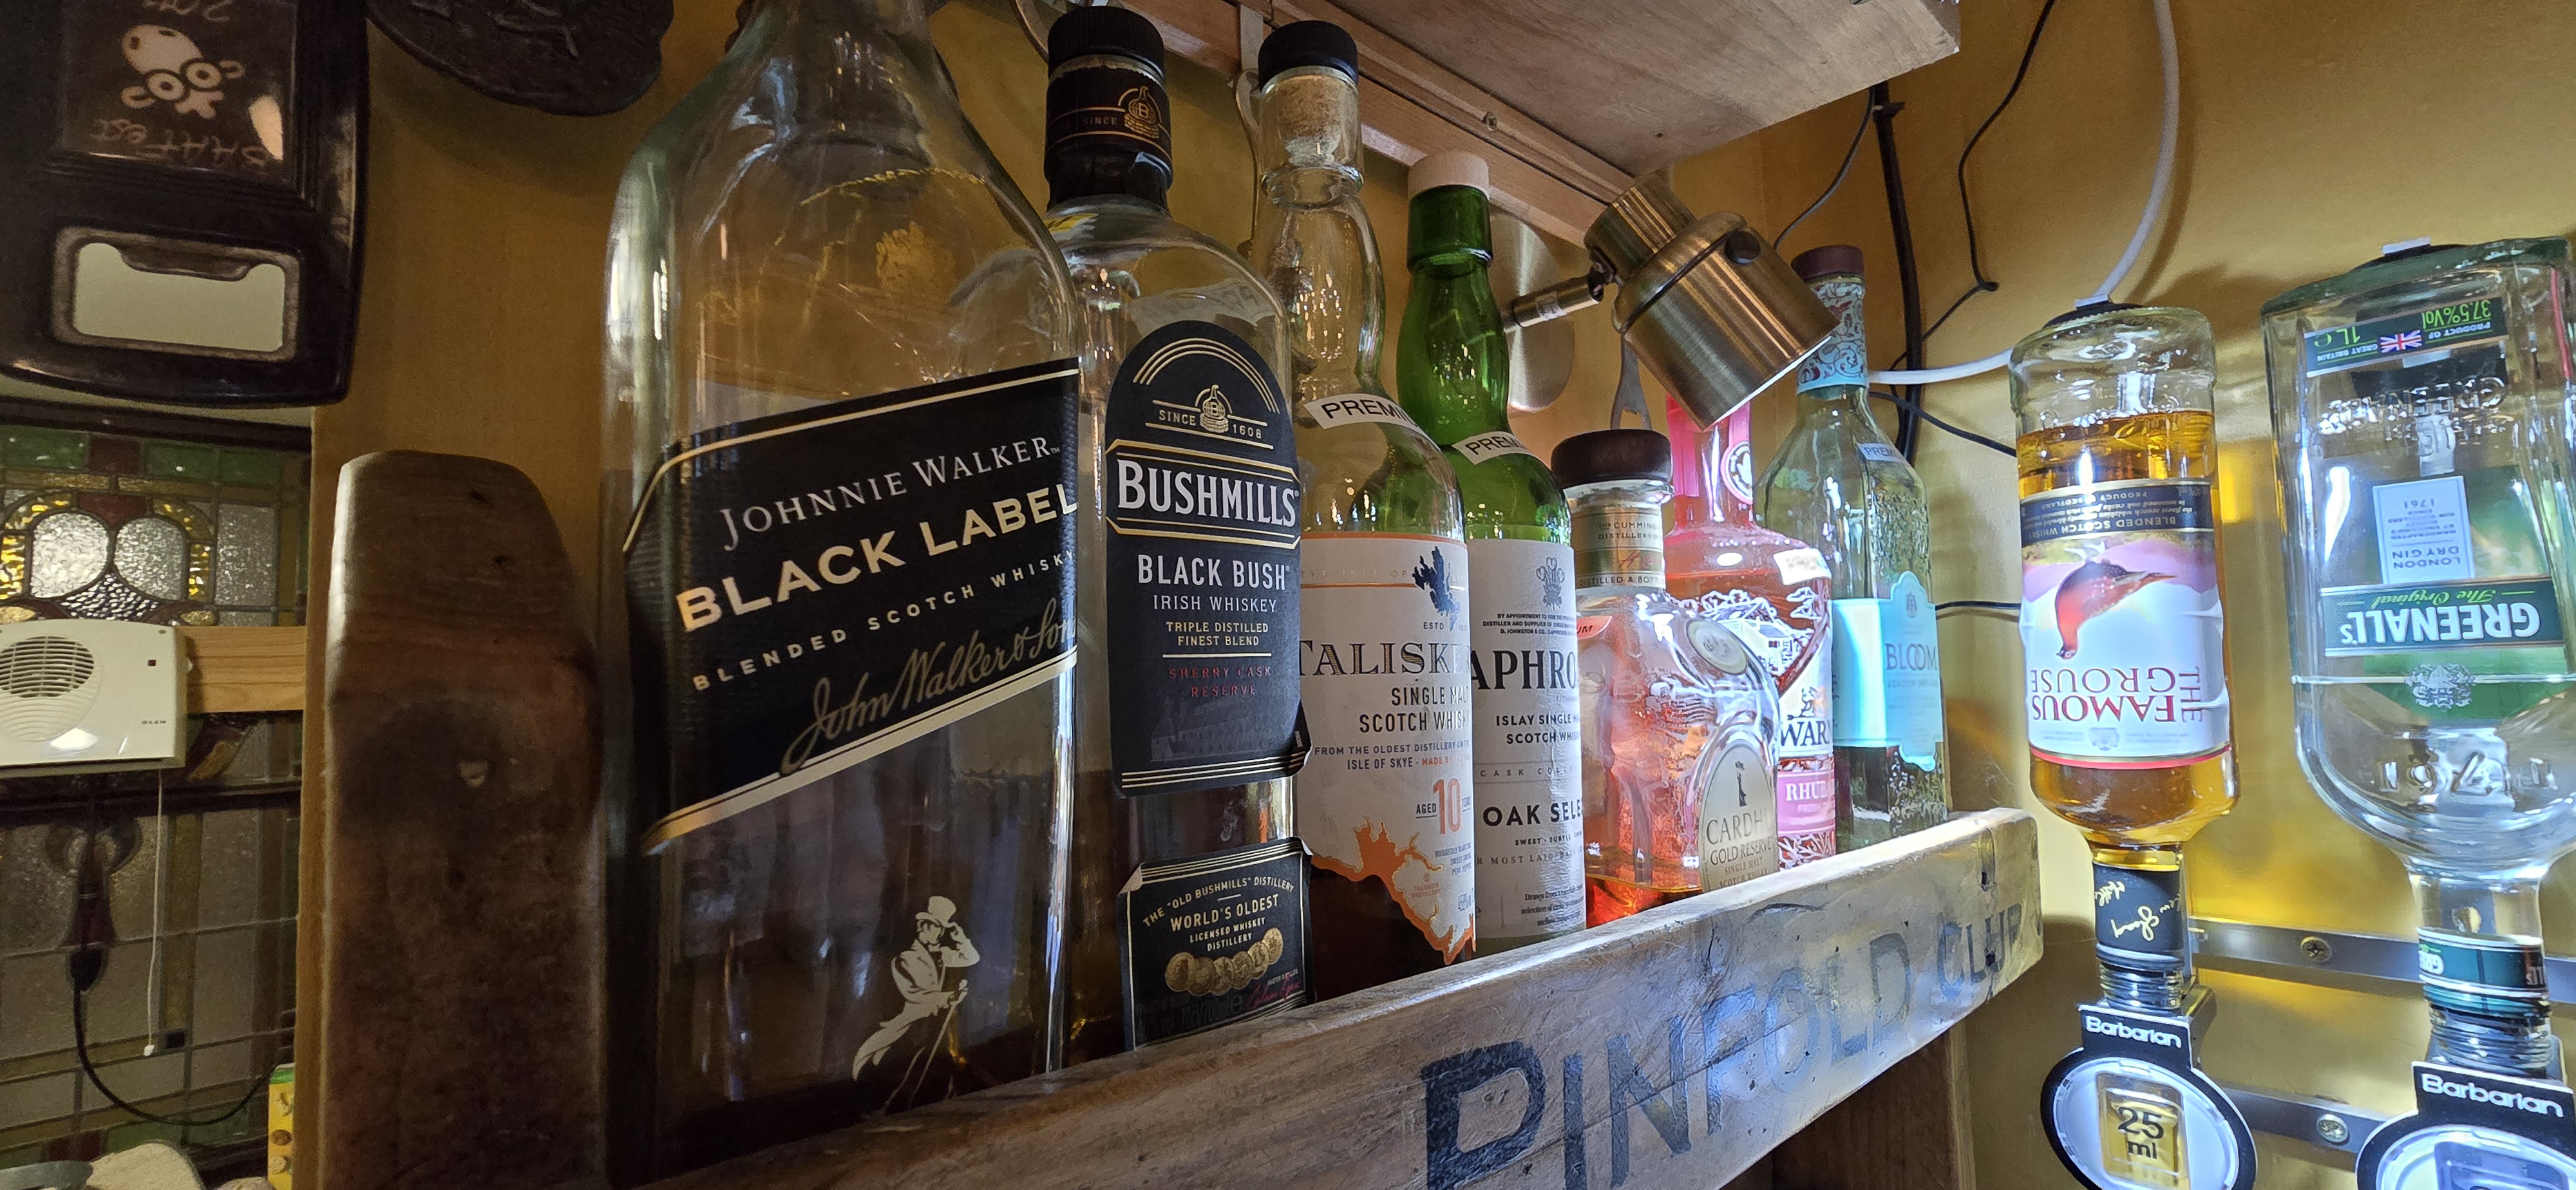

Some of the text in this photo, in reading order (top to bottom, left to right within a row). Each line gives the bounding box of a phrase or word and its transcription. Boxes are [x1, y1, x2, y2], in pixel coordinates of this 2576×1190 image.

[1083, 117, 1117, 125] SINCE
[2429, 321, 2491, 340] PRODUCT OF
[2317, 343, 2378, 362] GREAT BRITAIN
[1159, 410, 1262, 439] SINCE 1608
[2100, 491, 2148, 502] PRODUCT
[2403, 498, 2435, 509] 1761
[719, 471, 909, 550] JOHNNIE
[2061, 520, 2112, 533] SCOTCH
[2116, 516, 2176, 527] BLENDED
[675, 482, 1078, 632] BLACK LABEL
[2392, 546, 2459, 559] DRY GIN
[1138, 554, 1285, 590] BLACK BUSH
[2393, 557, 2461, 570] LONDON
[1578, 576, 1624, 585] DISTILLED
[1153, 595, 1277, 612] IRISH WHISKEY
[2371, 589, 2496, 609] The Original
[692, 551, 1074, 691] BLENDED SCOTCH WHISKY
[1166, 621, 1269, 632] TRIPLE DISTILLED
[1423, 621, 1444, 630] ESTD
[1178, 636, 1259, 646] FINEST BLEND
[1886, 643, 1938, 671] BLOOM
[1169, 666, 1272, 679] SHERRY CASK
[2031, 666, 2176, 694] GROUSE
[781, 677, 894, 773] John
[896, 628, 1013, 712] Walker
[1191, 685, 1256, 697] RESERVE
[1391, 687, 1446, 706] SINGLE
[2179, 666, 2203, 722] THE
[2032, 693, 2177, 722] FAMOUS
[1359, 712, 1427, 733] SCOTCH
[1496, 713, 1571, 726] ISLAY SINGLE
[1506, 732, 1557, 744] SCOTCH
[1781, 719, 1832, 747] WAR
[1349, 746, 1369, 755] THE
[1374, 744, 1410, 753] OLDEST
[1414, 741, 1455, 752] DISTILLERY
[1347, 759, 1370, 770] ISLE
[1374, 759, 1385, 769] OF
[1390, 757, 1413, 768] SKYE
[1422, 756, 1443, 766] MADE
[1480, 768, 1524, 777] CASK
[1416, 803, 1437, 815] AGED
[1433, 777, 1462, 835] 10
[1483, 804, 1541, 827] OAK
[1515, 838, 1541, 846] SWEET
[1710, 836, 1772, 866] GOLD RESERVE
[1490, 856, 1524, 865] MOST
[1725, 861, 1747, 876] SINGLE
[1142, 907, 1166, 927] THE
[1254, 876, 1294, 893] DISTILLERY
[1170, 893, 1279, 932] WORLD'S OLDEST
[1189, 917, 1266, 943] LICENSED WHISKEY
[1207, 932, 1253, 952] DISTILLERY
[2086, 1015, 2182, 1048] Barbarian
[1420, 933, 1912, 1190] PINFOLD
[2421, 1073, 2564, 1118] Barbarian
[2117, 1106, 2164, 1140] 25
[2127, 1140, 2157, 1160] ml
